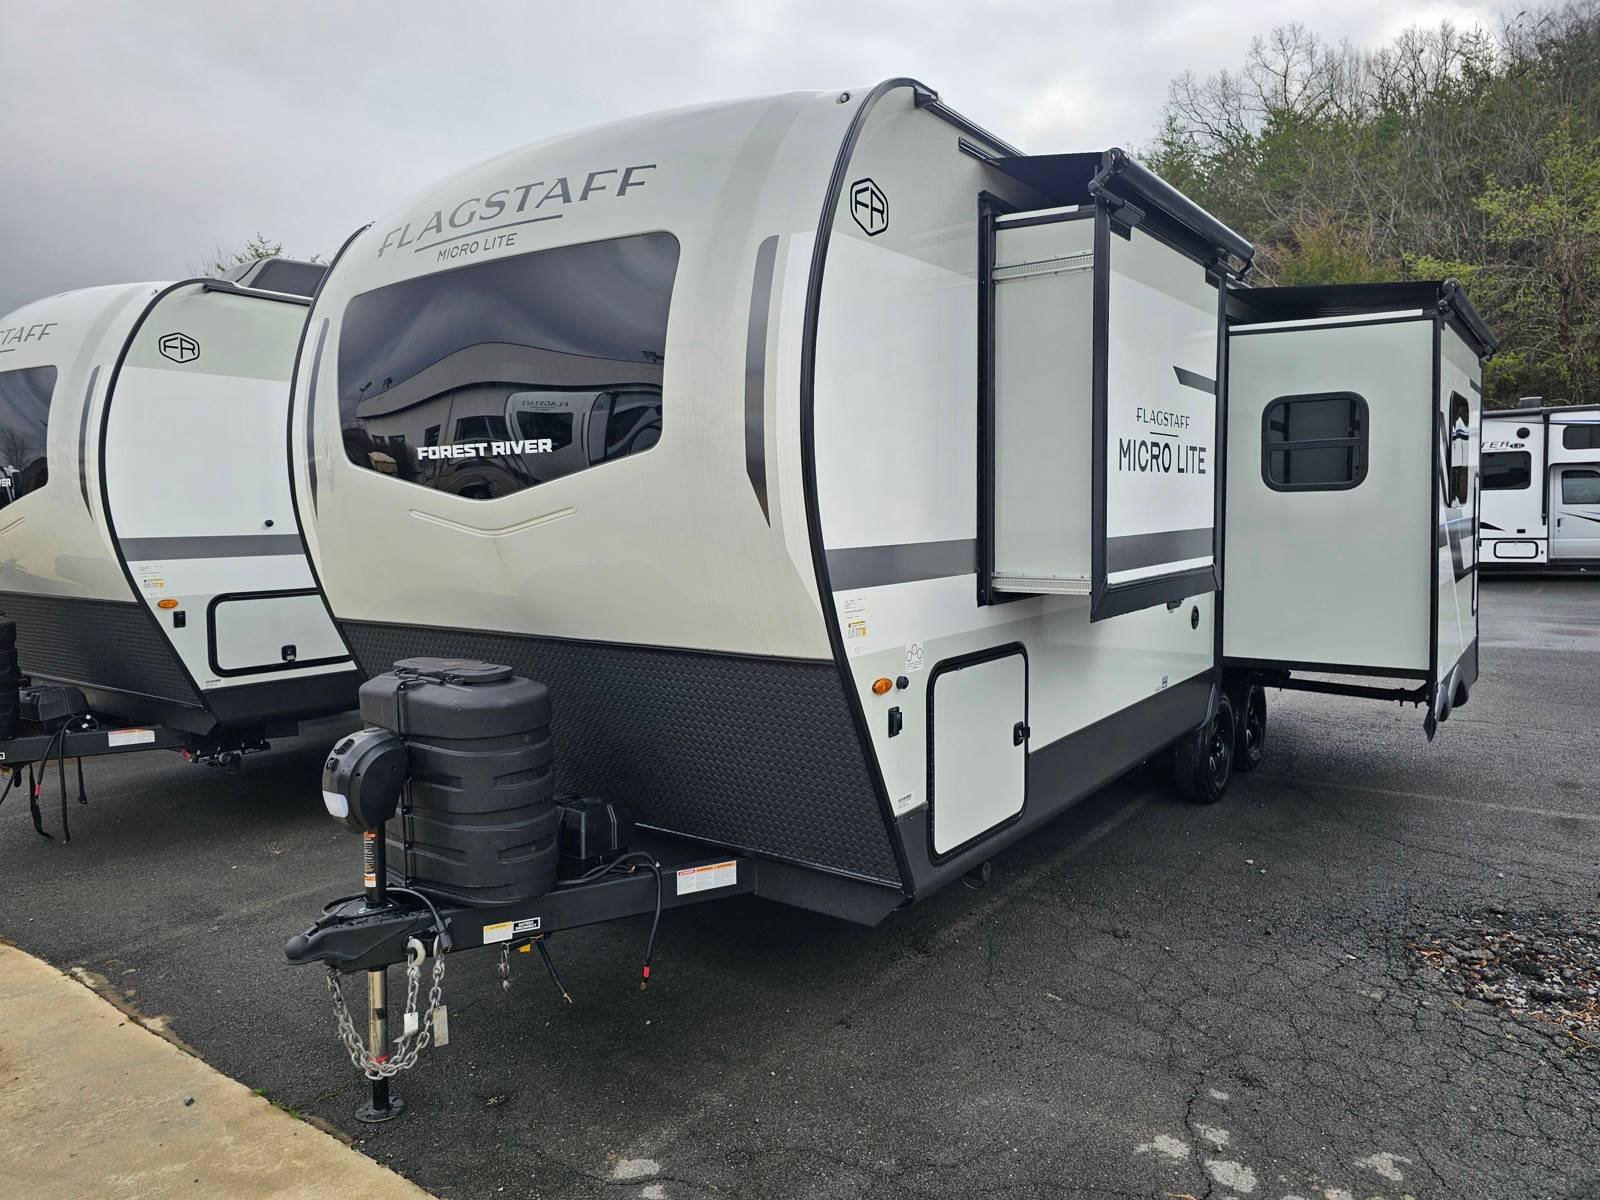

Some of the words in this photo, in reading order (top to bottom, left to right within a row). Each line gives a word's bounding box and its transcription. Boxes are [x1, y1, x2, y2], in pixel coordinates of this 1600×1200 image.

[377, 164, 657, 258] FLAGSTAFF
[437, 240, 479, 262] MICRO
[483, 232, 518, 251] LITE
[0, 322, 58, 345] TAFF
[1136, 407, 1191, 429] FLAGSTAFF
[416, 442, 488, 460] FOREST
[490, 438, 553, 456] RIVER
[1118, 437, 1172, 474] MICRO
[1177, 444, 1207, 475] LITE
[0, 478, 12, 487] ER
